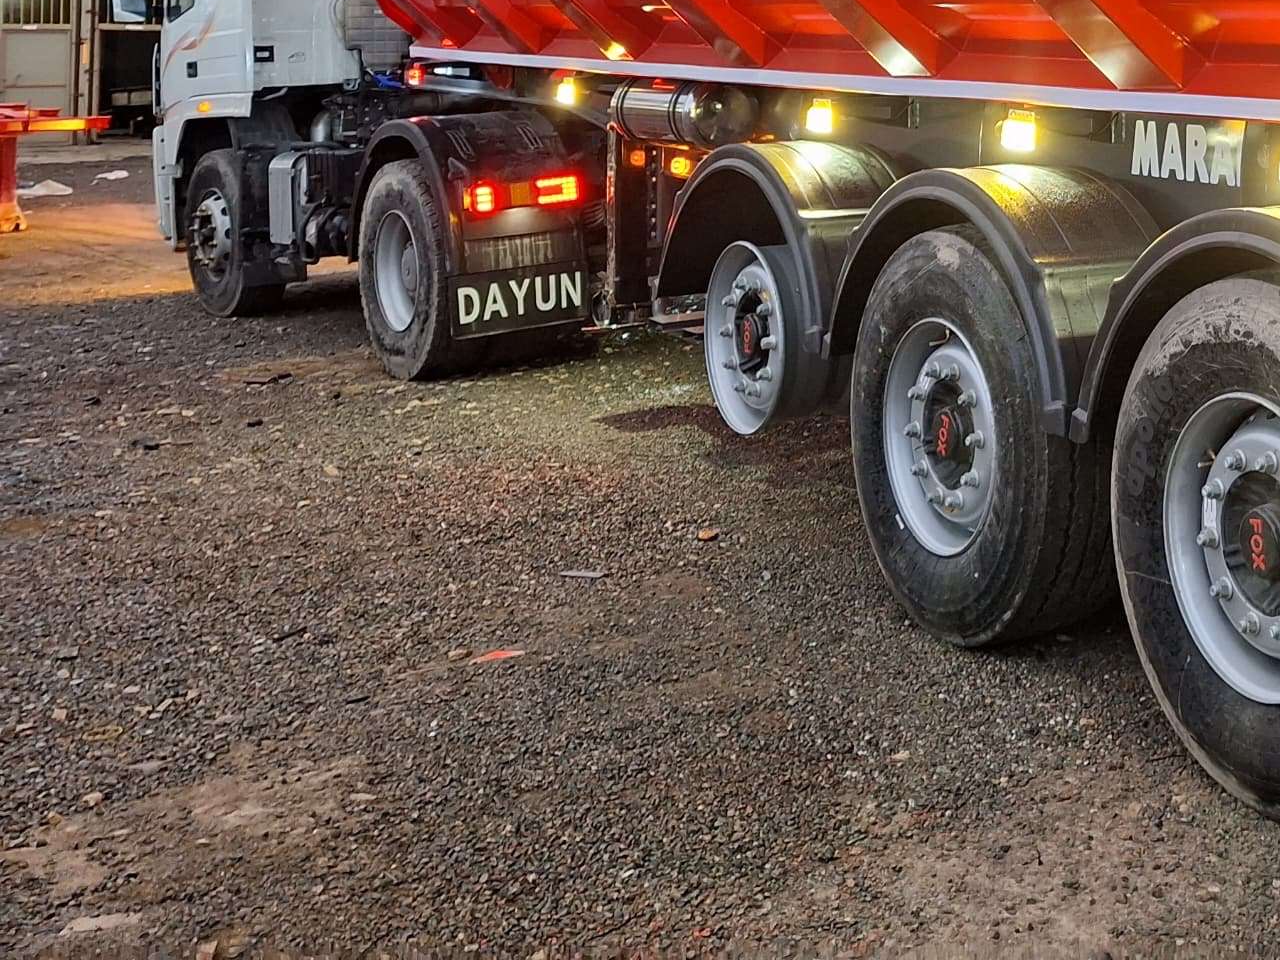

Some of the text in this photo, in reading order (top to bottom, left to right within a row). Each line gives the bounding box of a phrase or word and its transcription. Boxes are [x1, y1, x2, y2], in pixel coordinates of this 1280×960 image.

[457, 271, 582, 325] DAYUN
[743, 319, 753, 353] FOX
[936, 414, 950, 456] FOX
[1249, 518, 1266, 571] FOX
